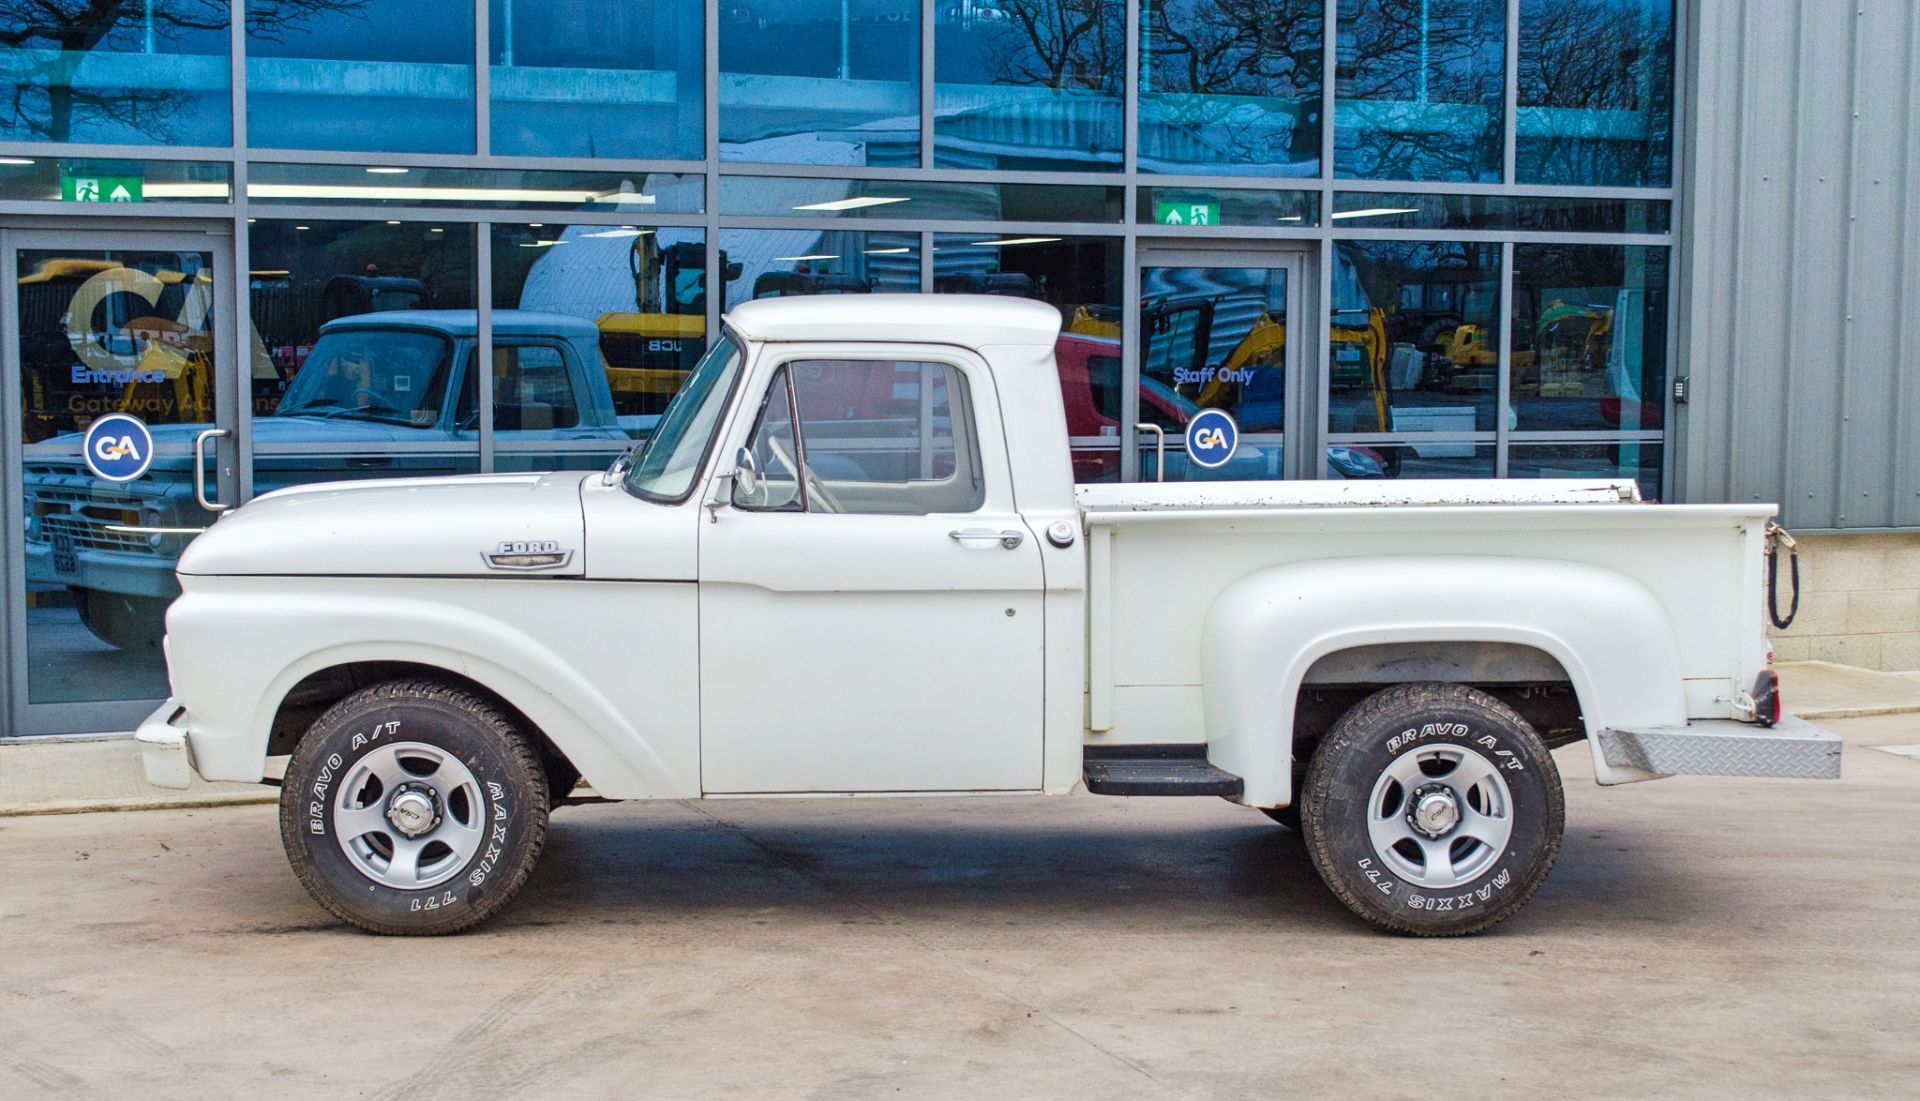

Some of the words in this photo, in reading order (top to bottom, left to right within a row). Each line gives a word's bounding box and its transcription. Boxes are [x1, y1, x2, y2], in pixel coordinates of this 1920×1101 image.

[71, 366, 165, 384] Entrance
[1173, 366, 1215, 383] Staff
[1217, 367, 1255, 386] Only
[68, 393, 175, 415] Gateway
[95, 435, 141, 461] GA
[1194, 427, 1228, 449] GA
[498, 540, 559, 553] FORD
[1386, 723, 1469, 753] BRAVO
[1477, 734, 1524, 772] A/T
[310, 753, 343, 835] BRAVO
[352, 721, 401, 751] A/T
[469, 781, 507, 887] MAXXIS
[1358, 858, 1395, 895] 771
[410, 891, 457, 911] 771
[1407, 869, 1511, 911] MAXXIS
